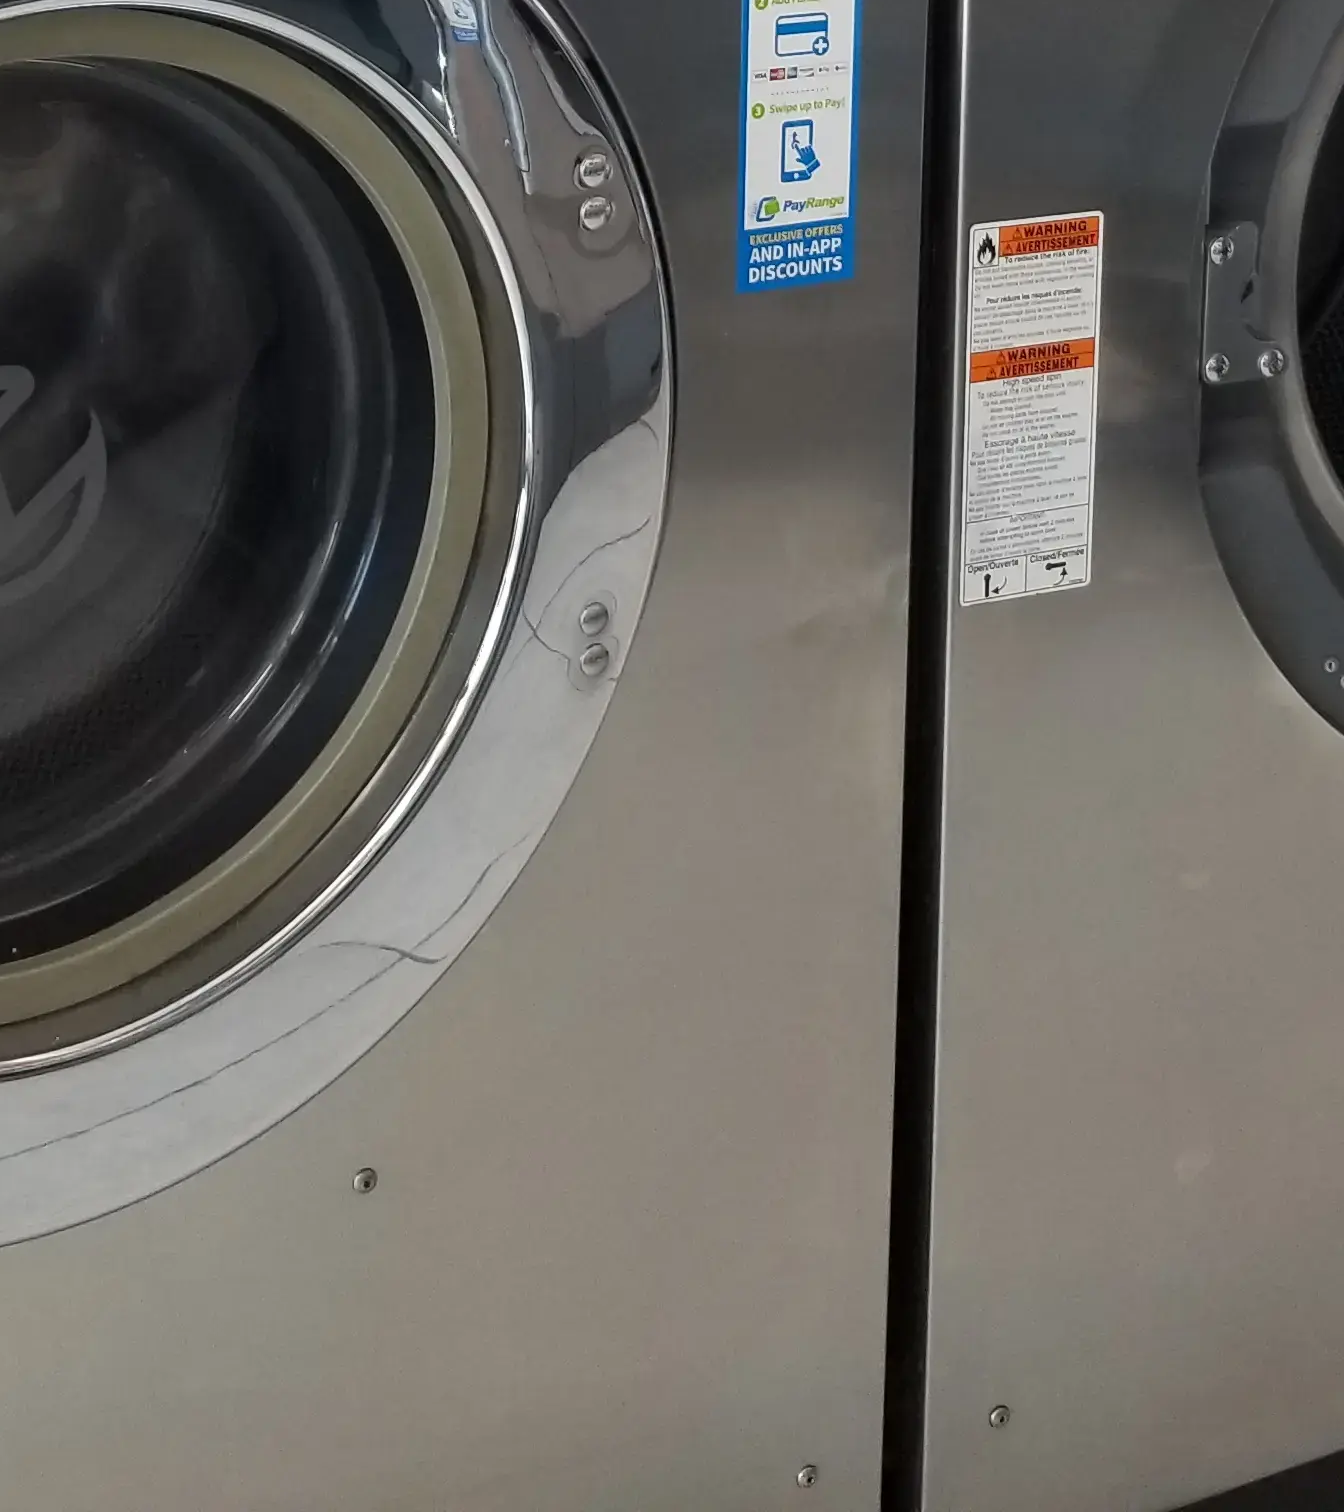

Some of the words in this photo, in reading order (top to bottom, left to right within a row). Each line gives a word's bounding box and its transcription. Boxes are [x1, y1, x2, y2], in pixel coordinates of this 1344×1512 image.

[769, 104, 797, 114] Swipe
[800, 103, 811, 113] up
[783, 196, 844, 212] PayRange
[750, 229, 803, 246] EXCLUSIVE
[805, 224, 843, 238] OFFERS
[1024, 220, 1087, 238] WARNING
[750, 245, 784, 264] AND
[788, 238, 842, 259] IN-APP
[1016, 234, 1096, 253] AVERTISSEMENT
[748, 256, 843, 284] DISCOUNTS
[1008, 344, 1071, 361] WARNING
[1000, 356, 1079, 377] AVERTISSEMENT
